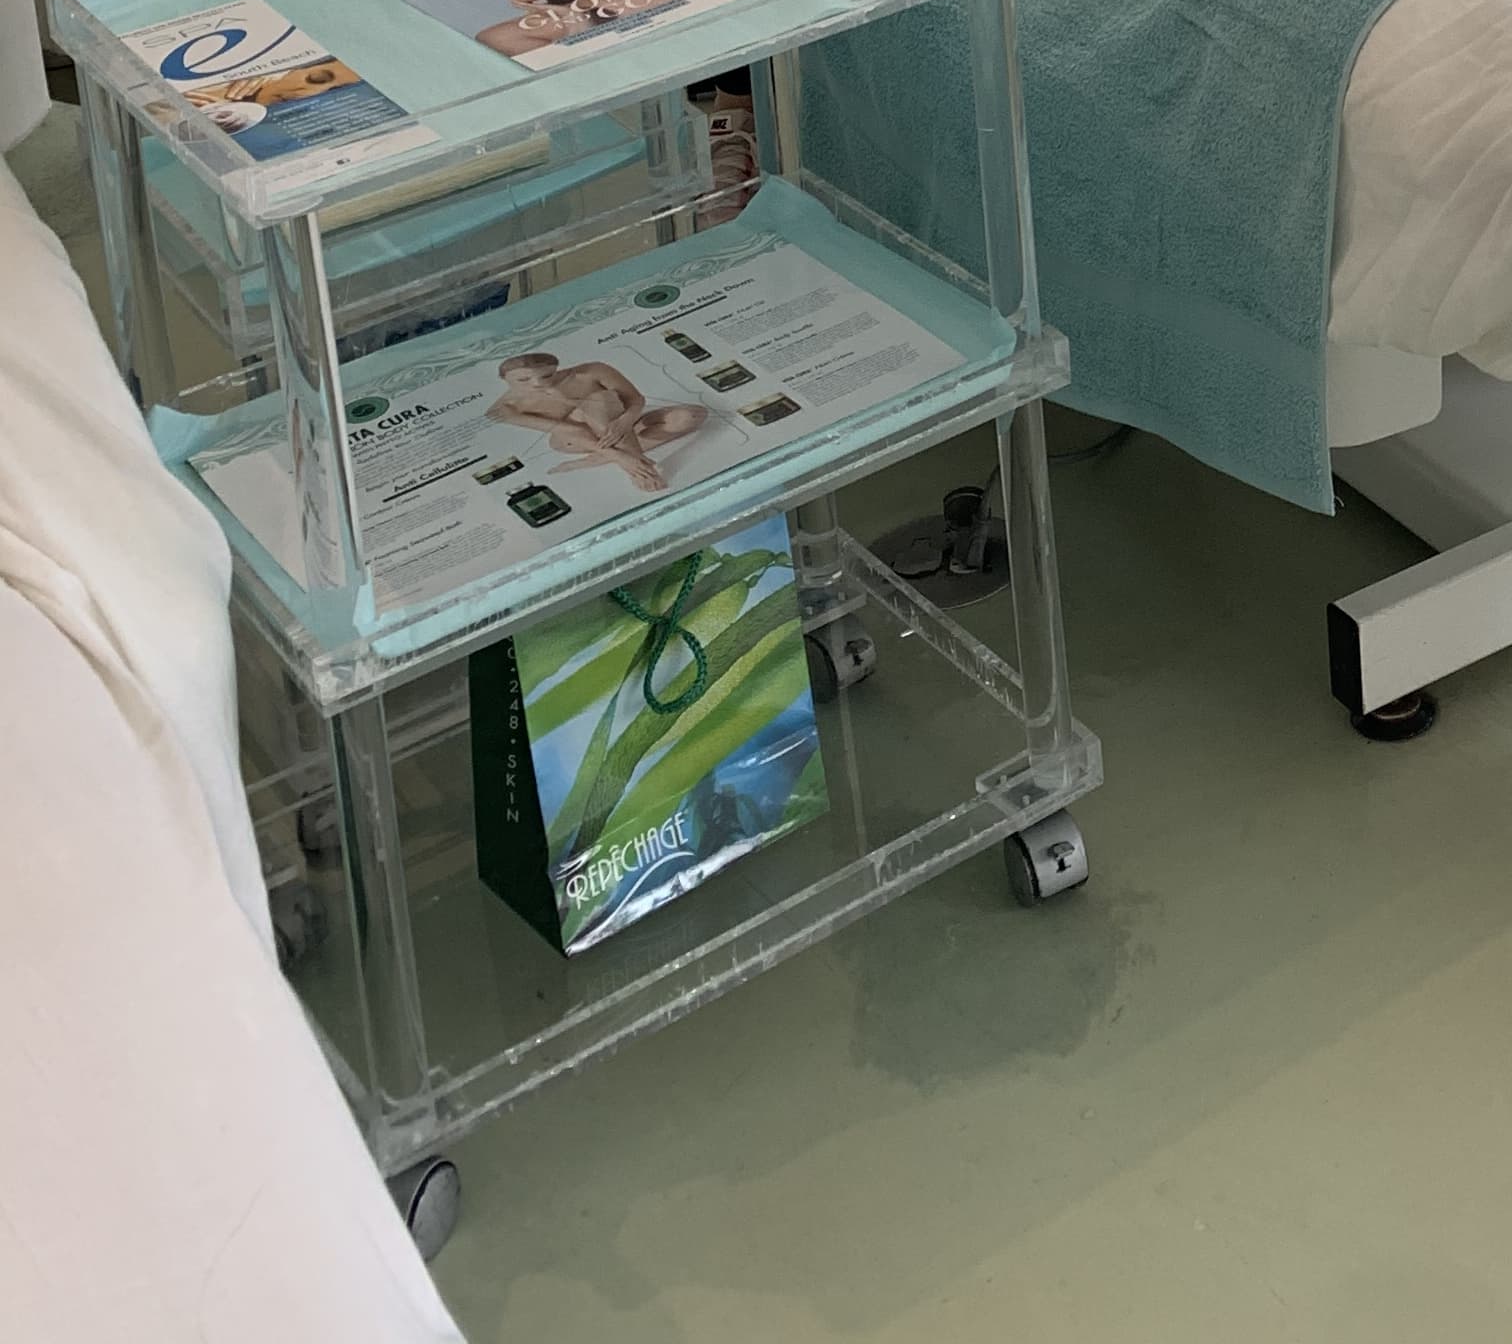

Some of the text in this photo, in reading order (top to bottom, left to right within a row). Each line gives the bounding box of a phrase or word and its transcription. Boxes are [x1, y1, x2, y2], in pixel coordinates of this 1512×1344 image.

[142, 16, 249, 49] SPA
[552, 12, 592, 31] AND
[711, 118, 729, 130] NIKE
[597, 331, 619, 345] Anti
[620, 318, 652, 337] Aging
[652, 309, 679, 325] from
[377, 404, 431, 430] CURA
[393, 477, 418, 493] Anti
[419, 456, 470, 481] Cellulite
